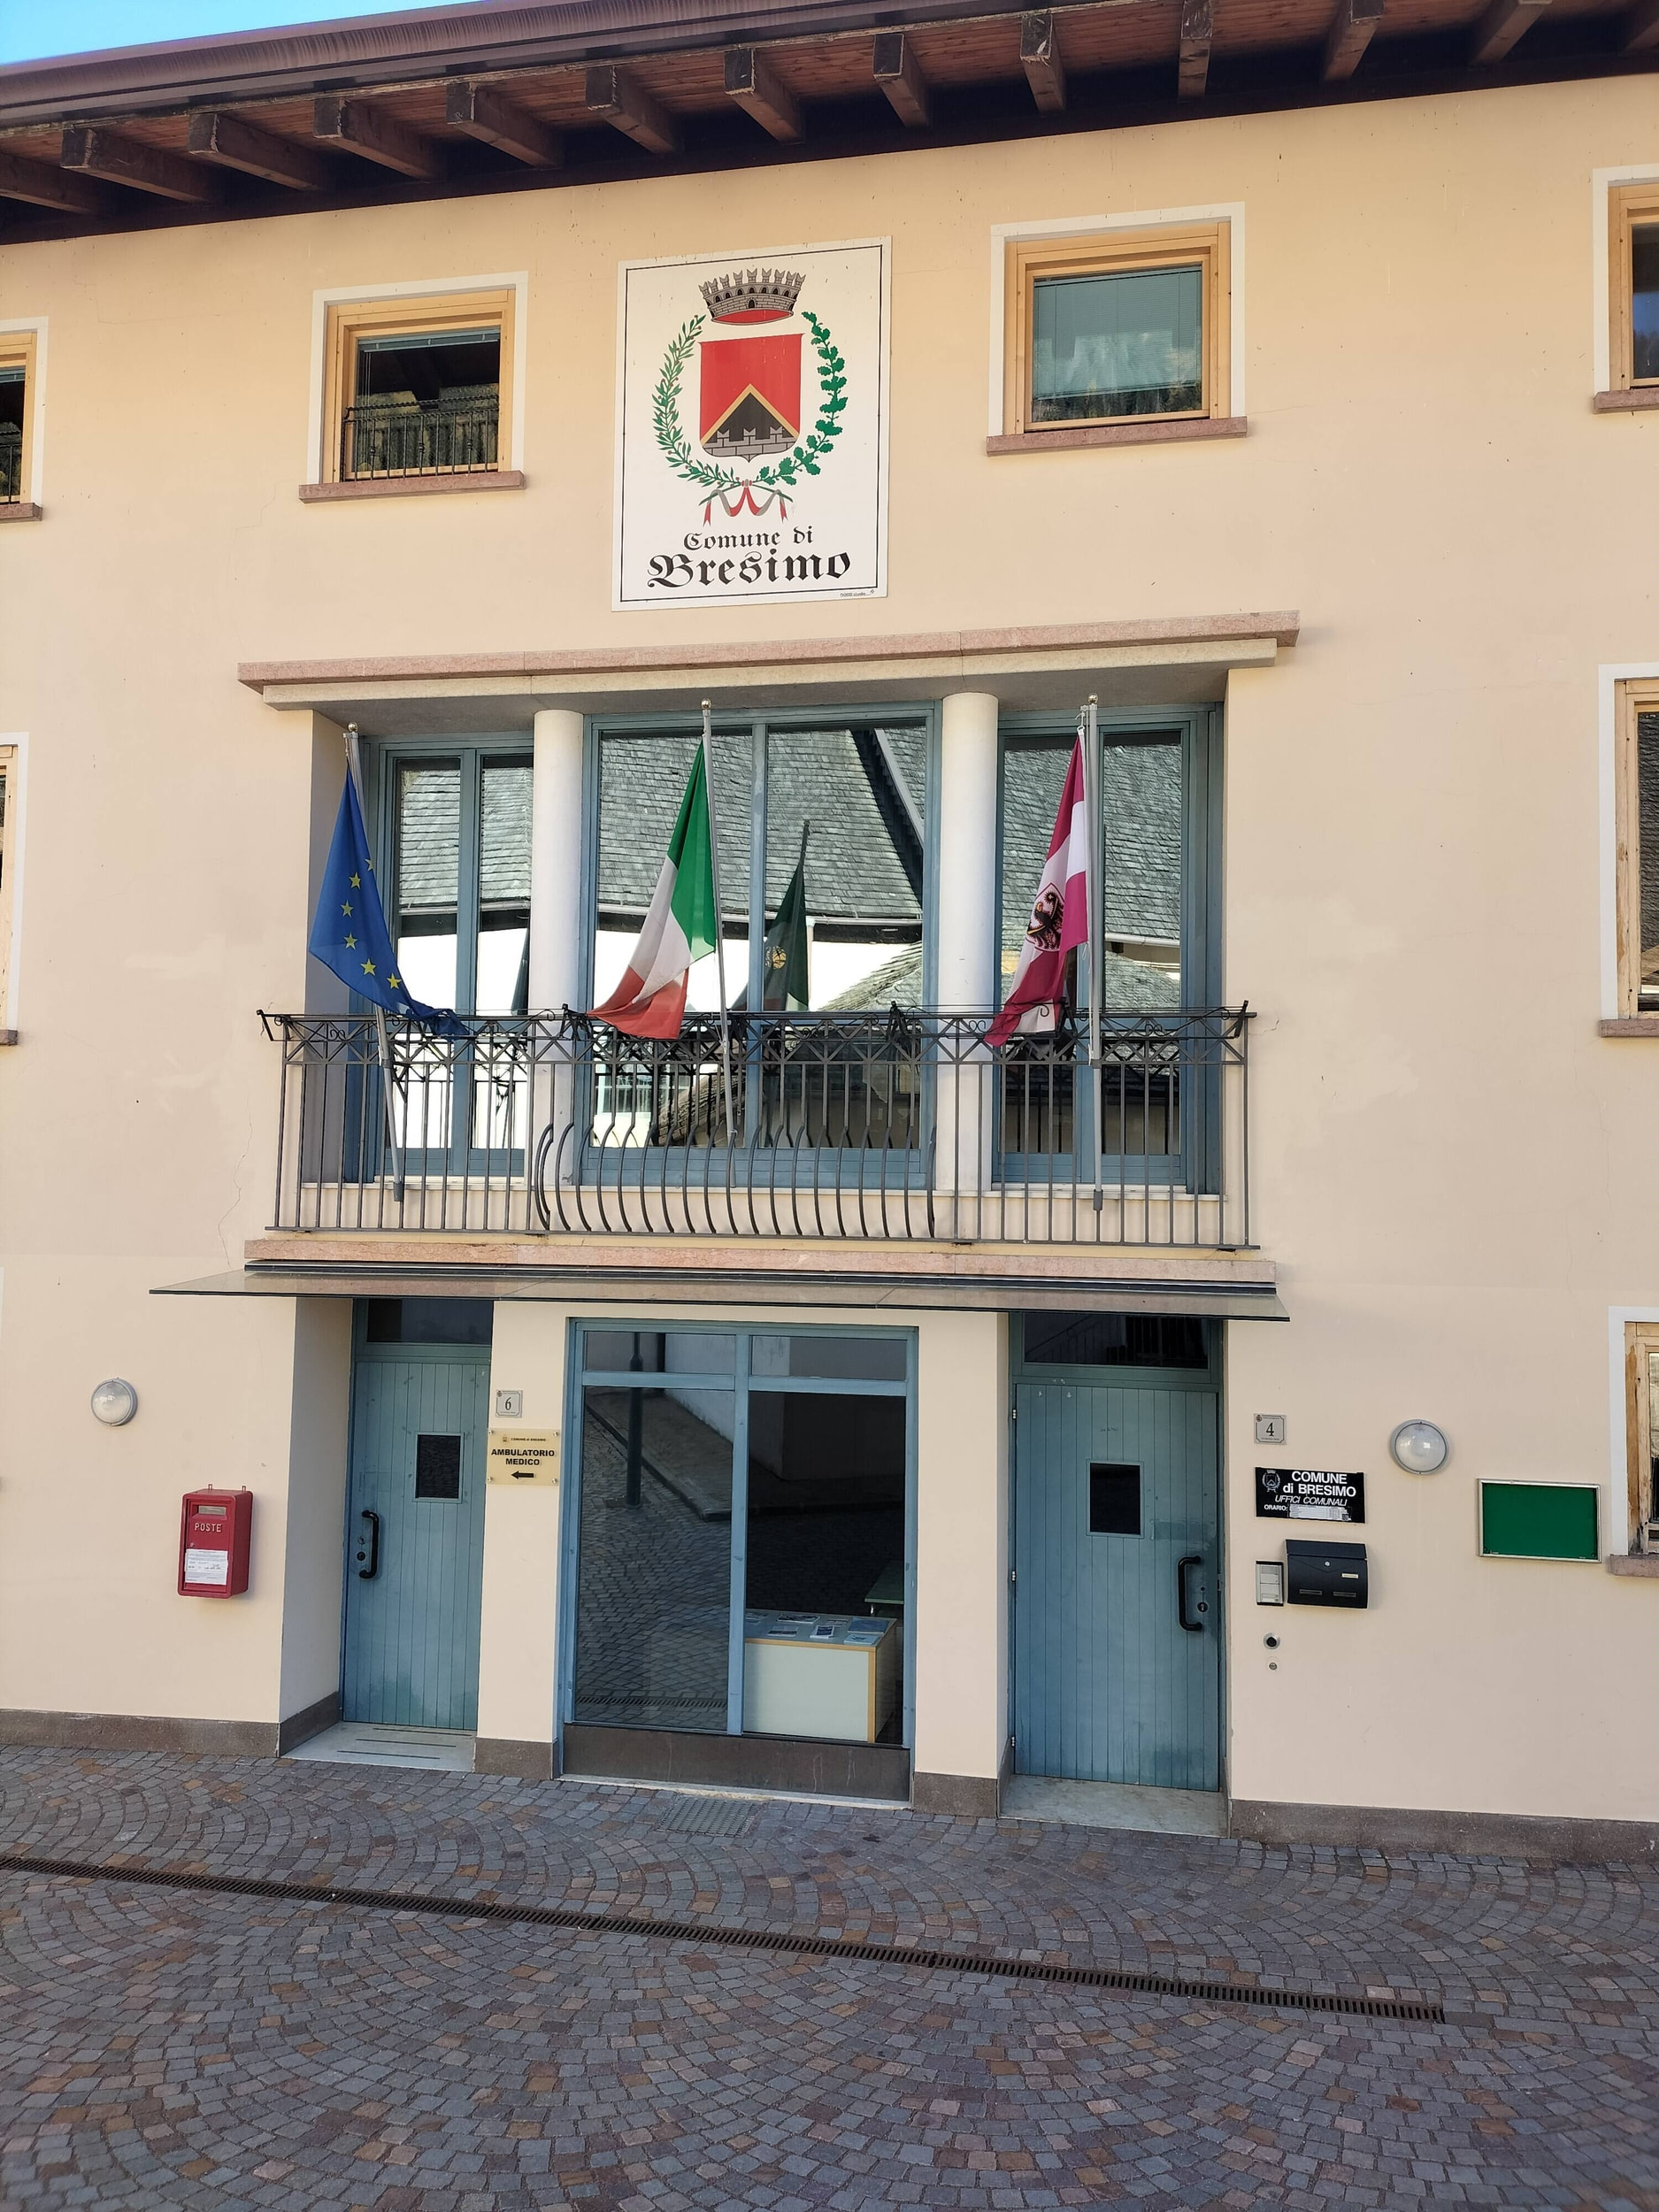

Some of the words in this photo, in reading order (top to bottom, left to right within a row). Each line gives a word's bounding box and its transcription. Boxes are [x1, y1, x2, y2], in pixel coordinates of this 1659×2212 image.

[683, 531, 780, 550] Comune
[793, 526, 813, 544] di
[647, 548, 851, 588] Bresimo
[504, 1396, 511, 1410] 6
[1265, 1422, 1275, 1437] 4
[491, 1448, 555, 1457] AMBULATORIO
[1291, 1471, 1348, 1485] COMUNE
[1282, 1483, 1294, 1494] di
[1298, 1483, 1356, 1497] BRESIMO
[1274, 1494, 1301, 1504] UFFICI
[1302, 1496, 1348, 1506] COMUNALI
[194, 1522, 222, 1532] POSTE
